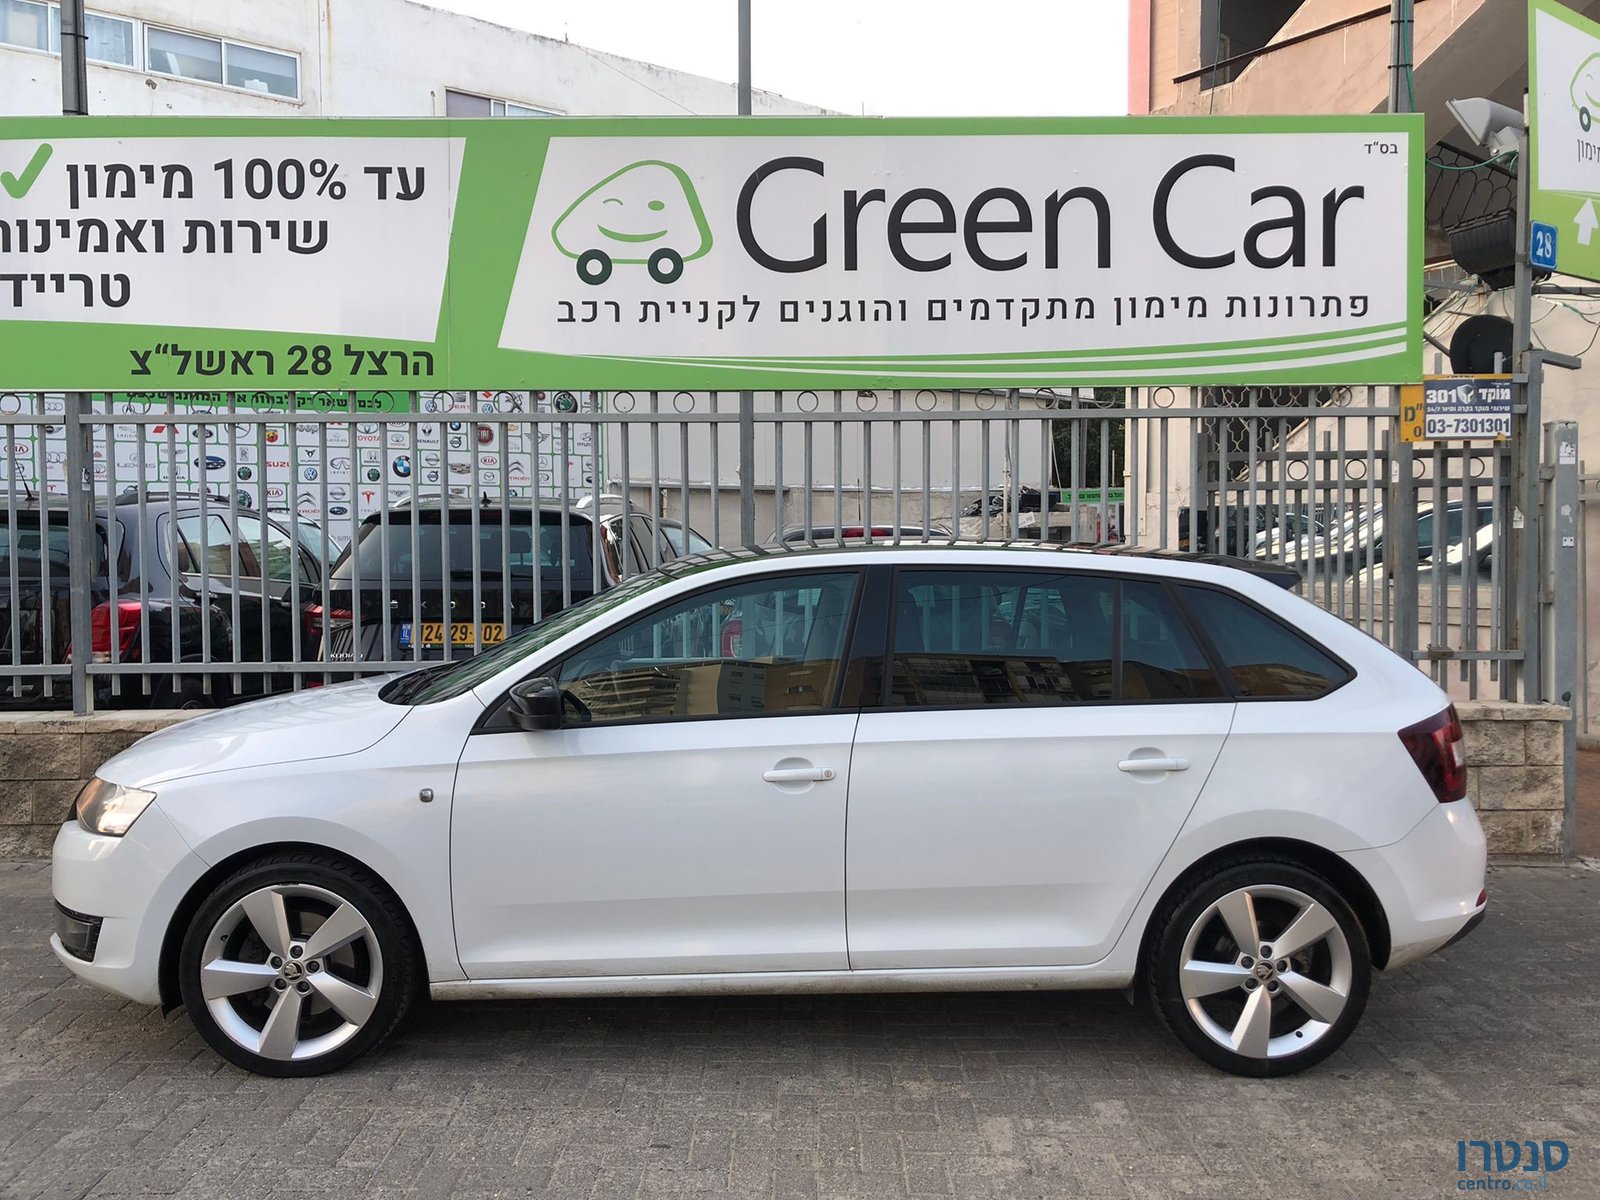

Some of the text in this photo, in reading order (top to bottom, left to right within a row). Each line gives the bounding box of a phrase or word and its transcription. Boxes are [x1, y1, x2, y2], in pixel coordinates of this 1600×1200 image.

[1364, 141, 1399, 156] בס"ד
[66, 158, 425, 209] עד 100% מימון
[736, 154, 1365, 273] Green Car
[182, 219, 328, 254] שירות
[1536, 230, 1552, 258] 28
[0, 273, 131, 308] טרייד
[557, 295, 1369, 330] פתרונות מימון מתקדמים והוגנים לקניית רכב
[130, 342, 434, 376] הרצל 28 ראשל"צ
[1426, 385, 1511, 404] מוקד 301
[1427, 418, 1510, 434] 03-7301301
